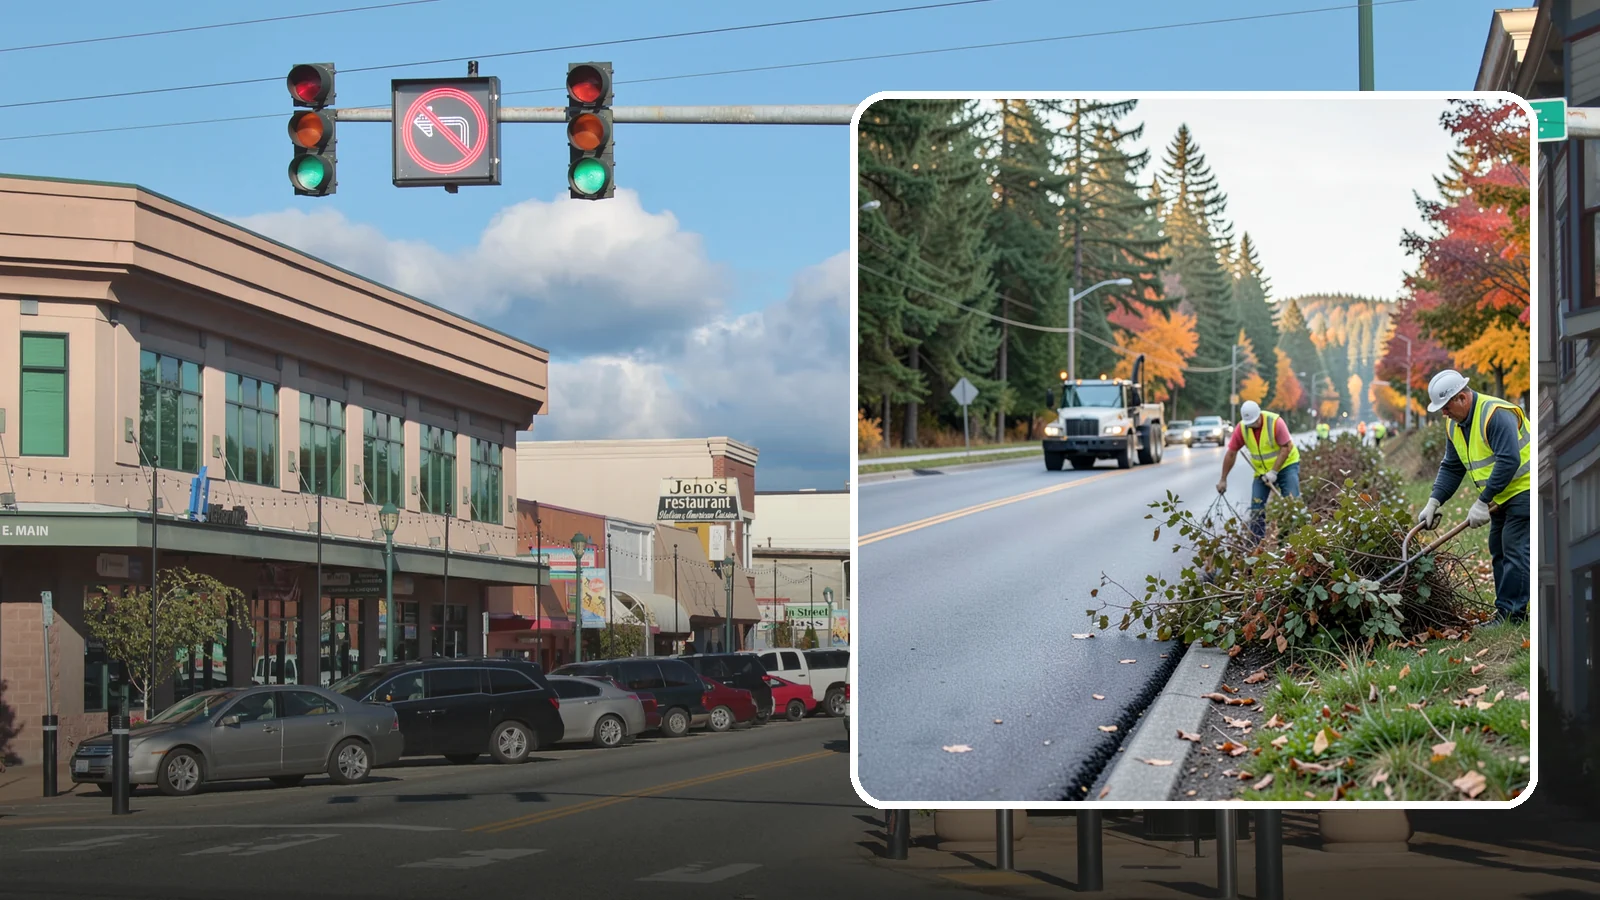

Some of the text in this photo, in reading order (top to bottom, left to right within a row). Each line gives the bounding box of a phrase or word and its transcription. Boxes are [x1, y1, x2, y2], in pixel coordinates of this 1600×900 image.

[670, 480, 728, 494] Jeno's
[665, 496, 731, 509] restaurant
[658, 510, 681, 519] Italian
[686, 509, 715, 519] American
[714, 509, 737, 519] Cuisine
[2, 525, 49, 536] E. MAIN
[797, 607, 828, 616] Street
